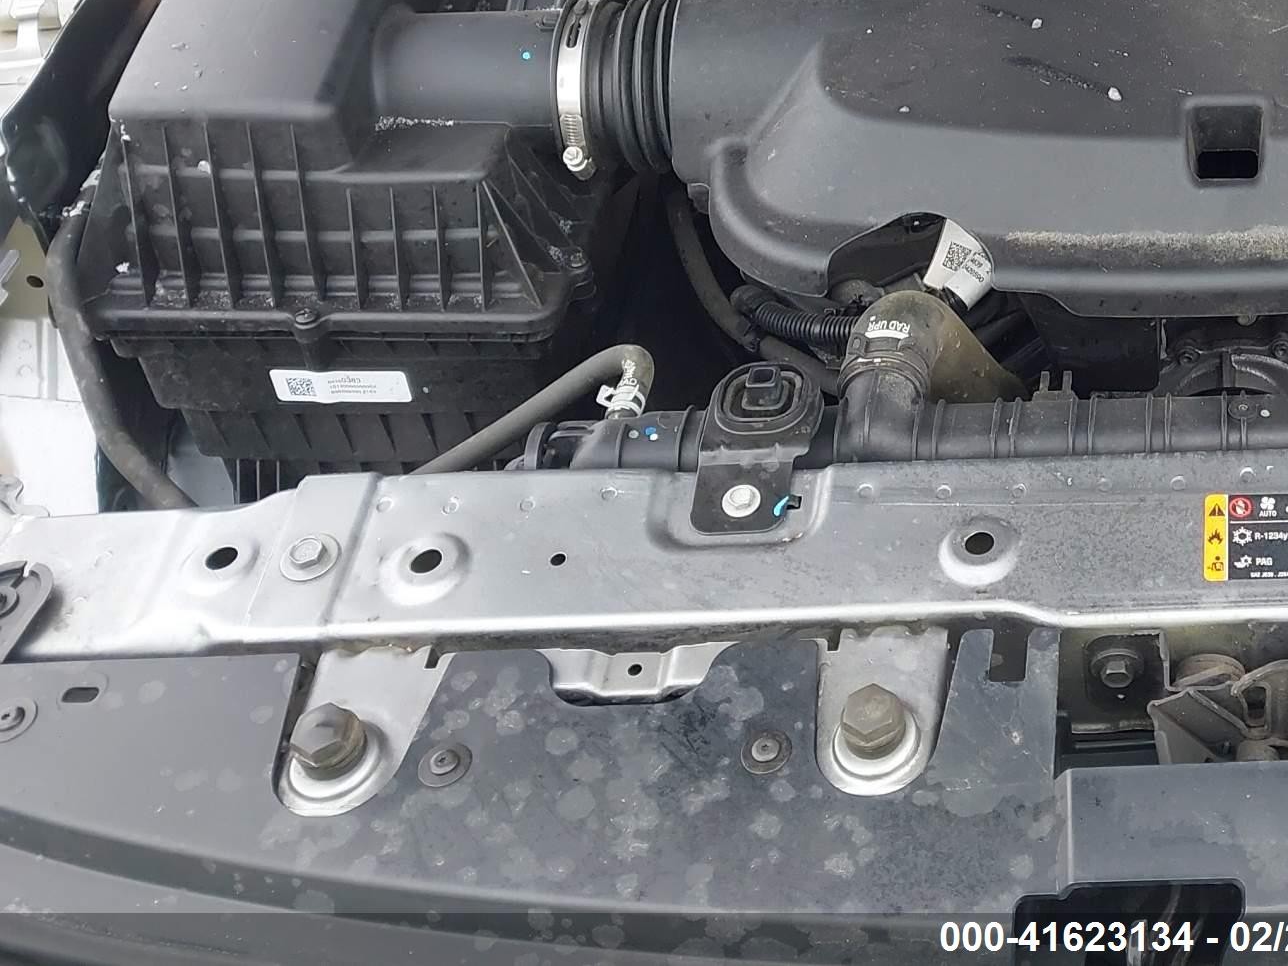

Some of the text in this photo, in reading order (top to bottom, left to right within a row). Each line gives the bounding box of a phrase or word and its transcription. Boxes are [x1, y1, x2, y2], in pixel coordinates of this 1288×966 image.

[867, 320, 911, 333] RAD UPR
[1255, 557, 1273, 566] PAG
